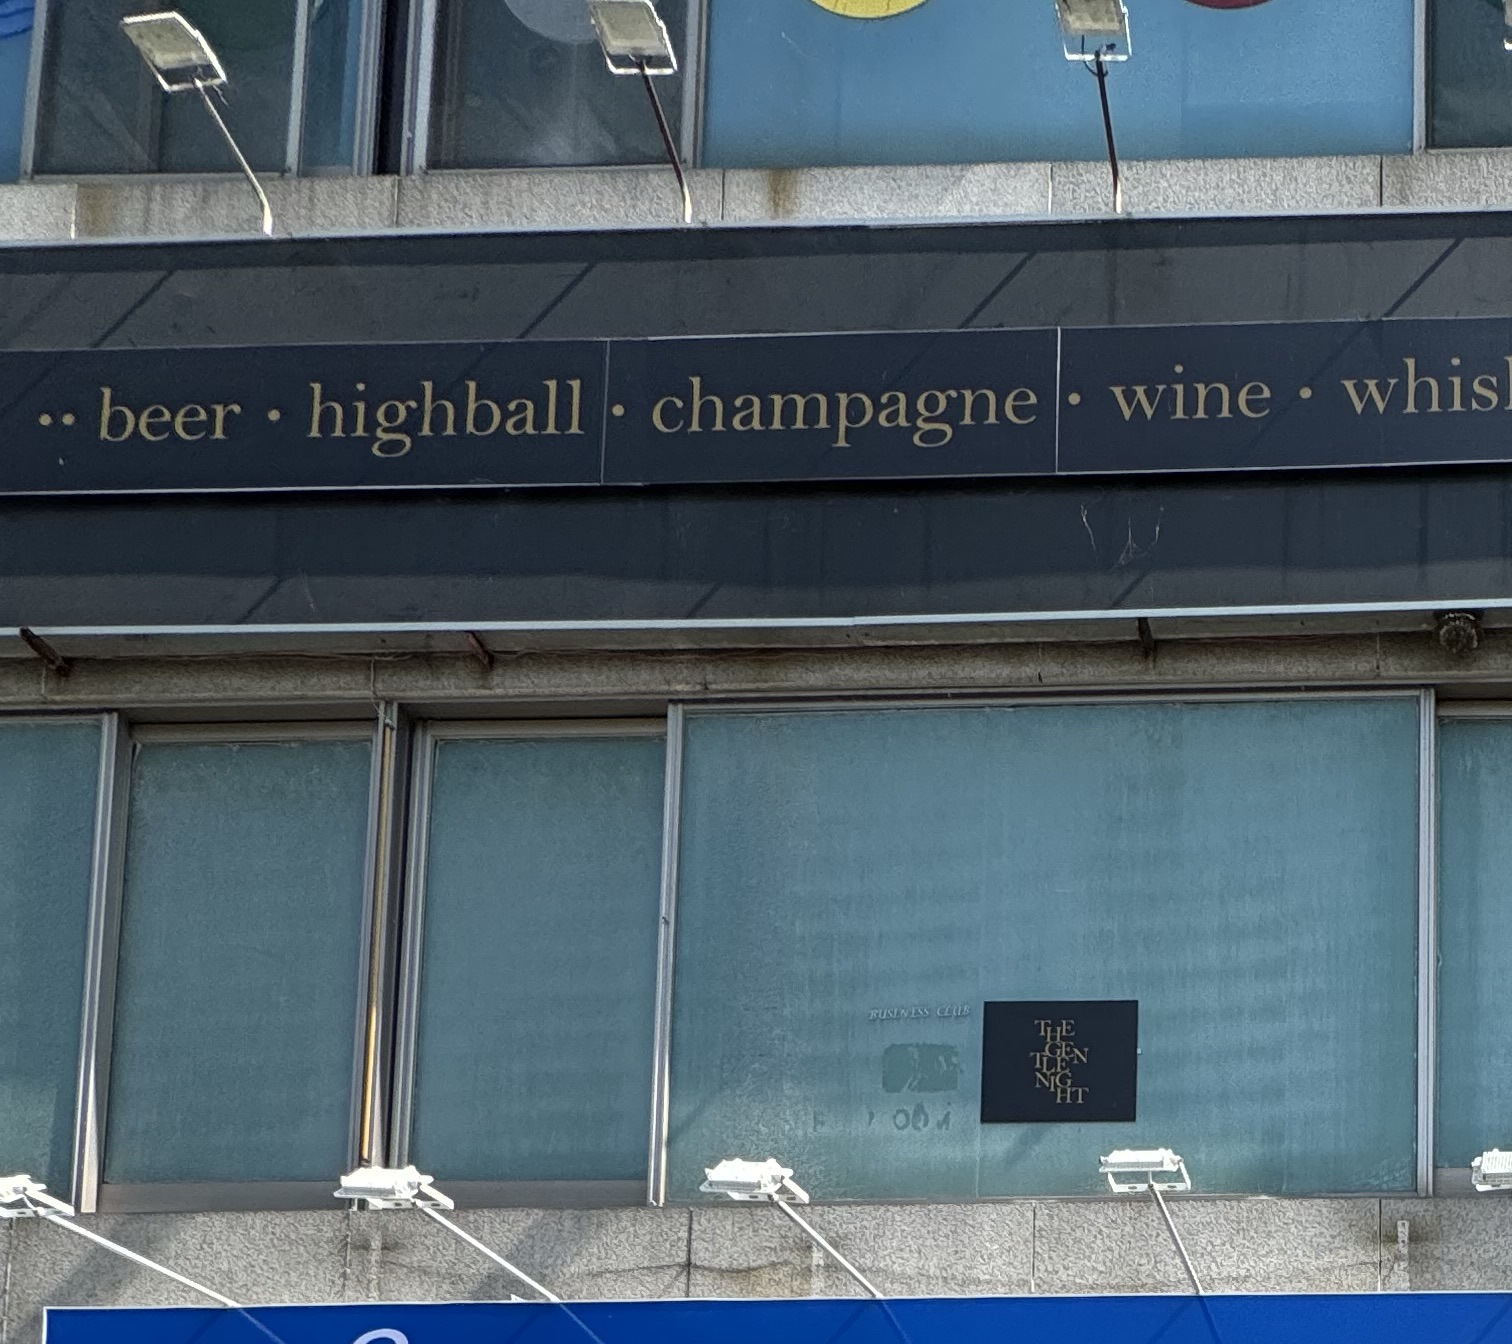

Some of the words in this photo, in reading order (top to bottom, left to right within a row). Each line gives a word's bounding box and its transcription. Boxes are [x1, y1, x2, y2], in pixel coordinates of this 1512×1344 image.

[100, 388, 242, 442] beer
[307, 378, 586, 458] highball
[652, 376, 1038, 447] champagne
[1110, 364, 1272, 421] wine
